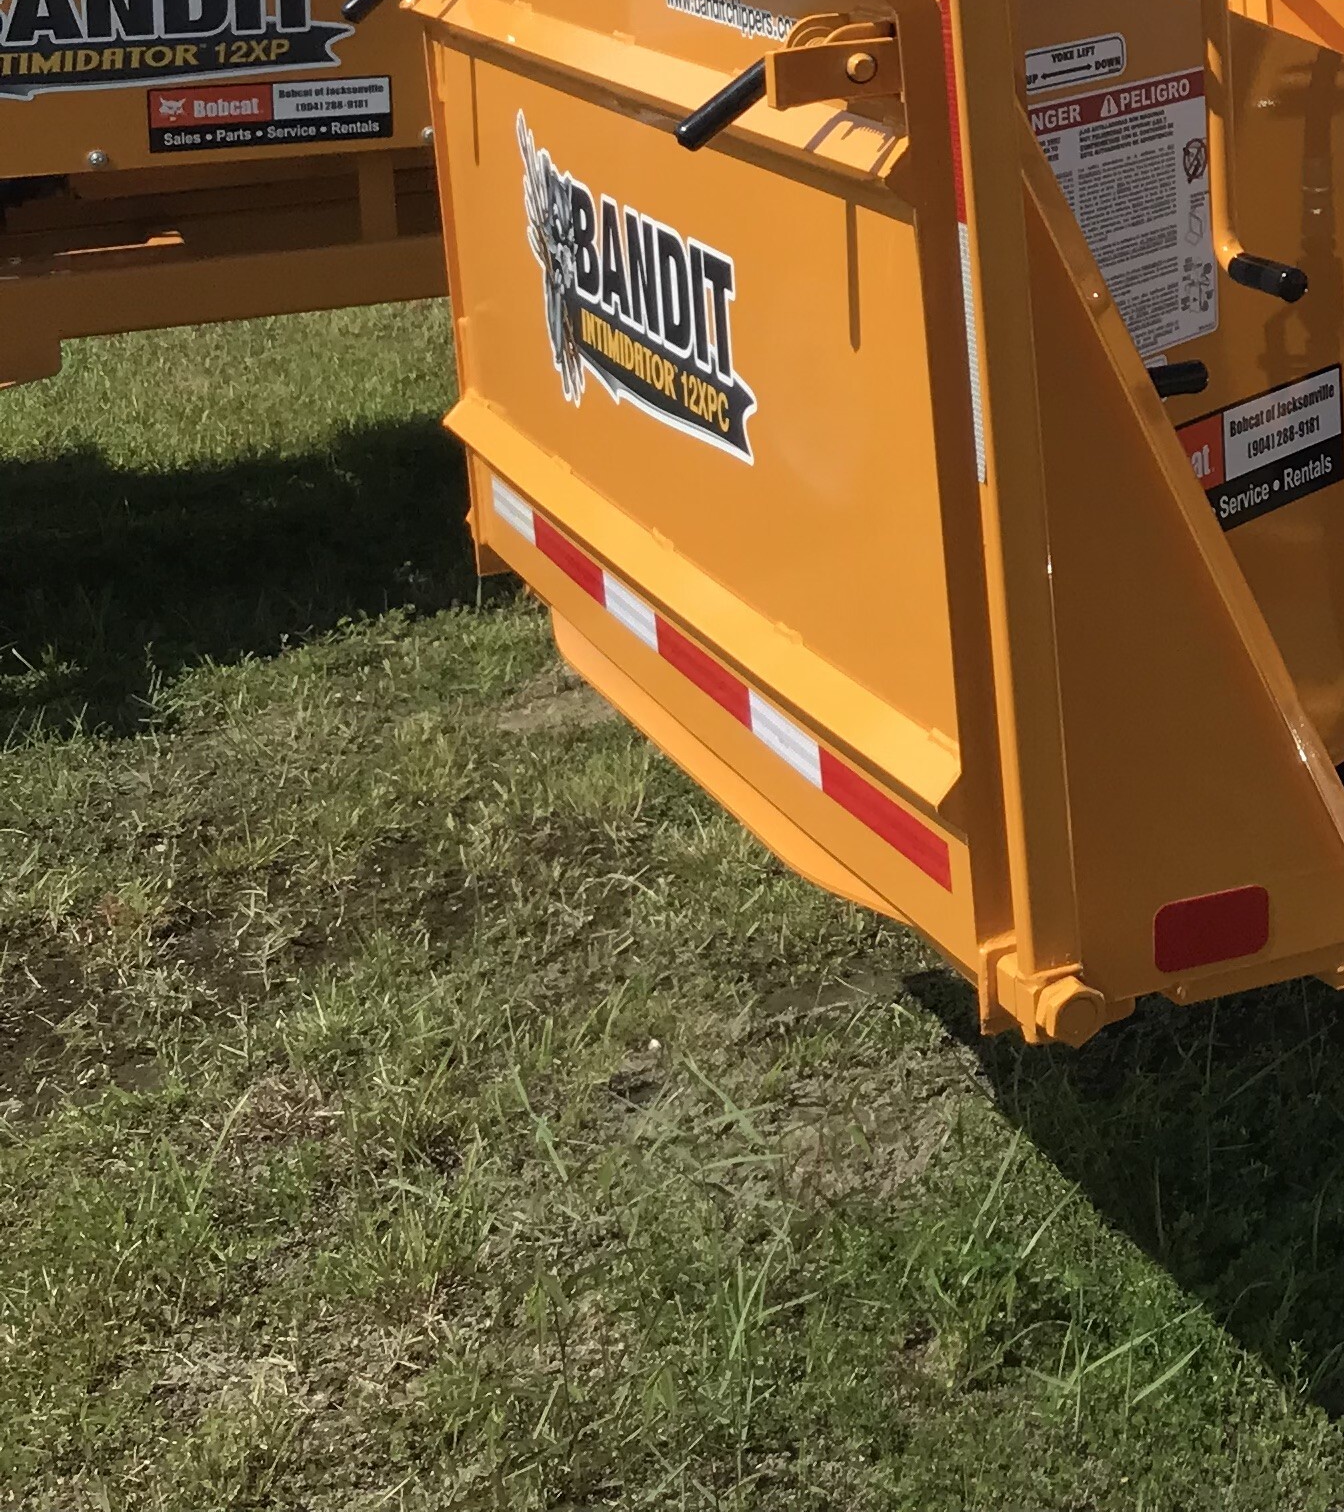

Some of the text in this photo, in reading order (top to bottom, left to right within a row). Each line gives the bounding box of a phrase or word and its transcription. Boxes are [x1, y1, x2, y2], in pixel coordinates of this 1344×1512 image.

[0, 39, 290, 76] TIMIDATOR 12XP
[1051, 46, 1095, 63] YOKE LIFT
[1095, 56, 1121, 70] DOWN
[194, 98, 260, 117] Bobcat
[279, 89, 312, 98] Bobcat
[1031, 78, 1190, 131] NGER PELIGRO
[164, 119, 380, 146] Sales Parts Service Rentals
[571, 183, 733, 380] BANDIT
[581, 307, 730, 432] INTIMIDATOR 12XPC
[1230, 383, 1335, 438] Bobcat of Jacksonville
[1247, 415, 1320, 459] (904) 288-9181
[1219, 453, 1332, 518] Service Rentals
